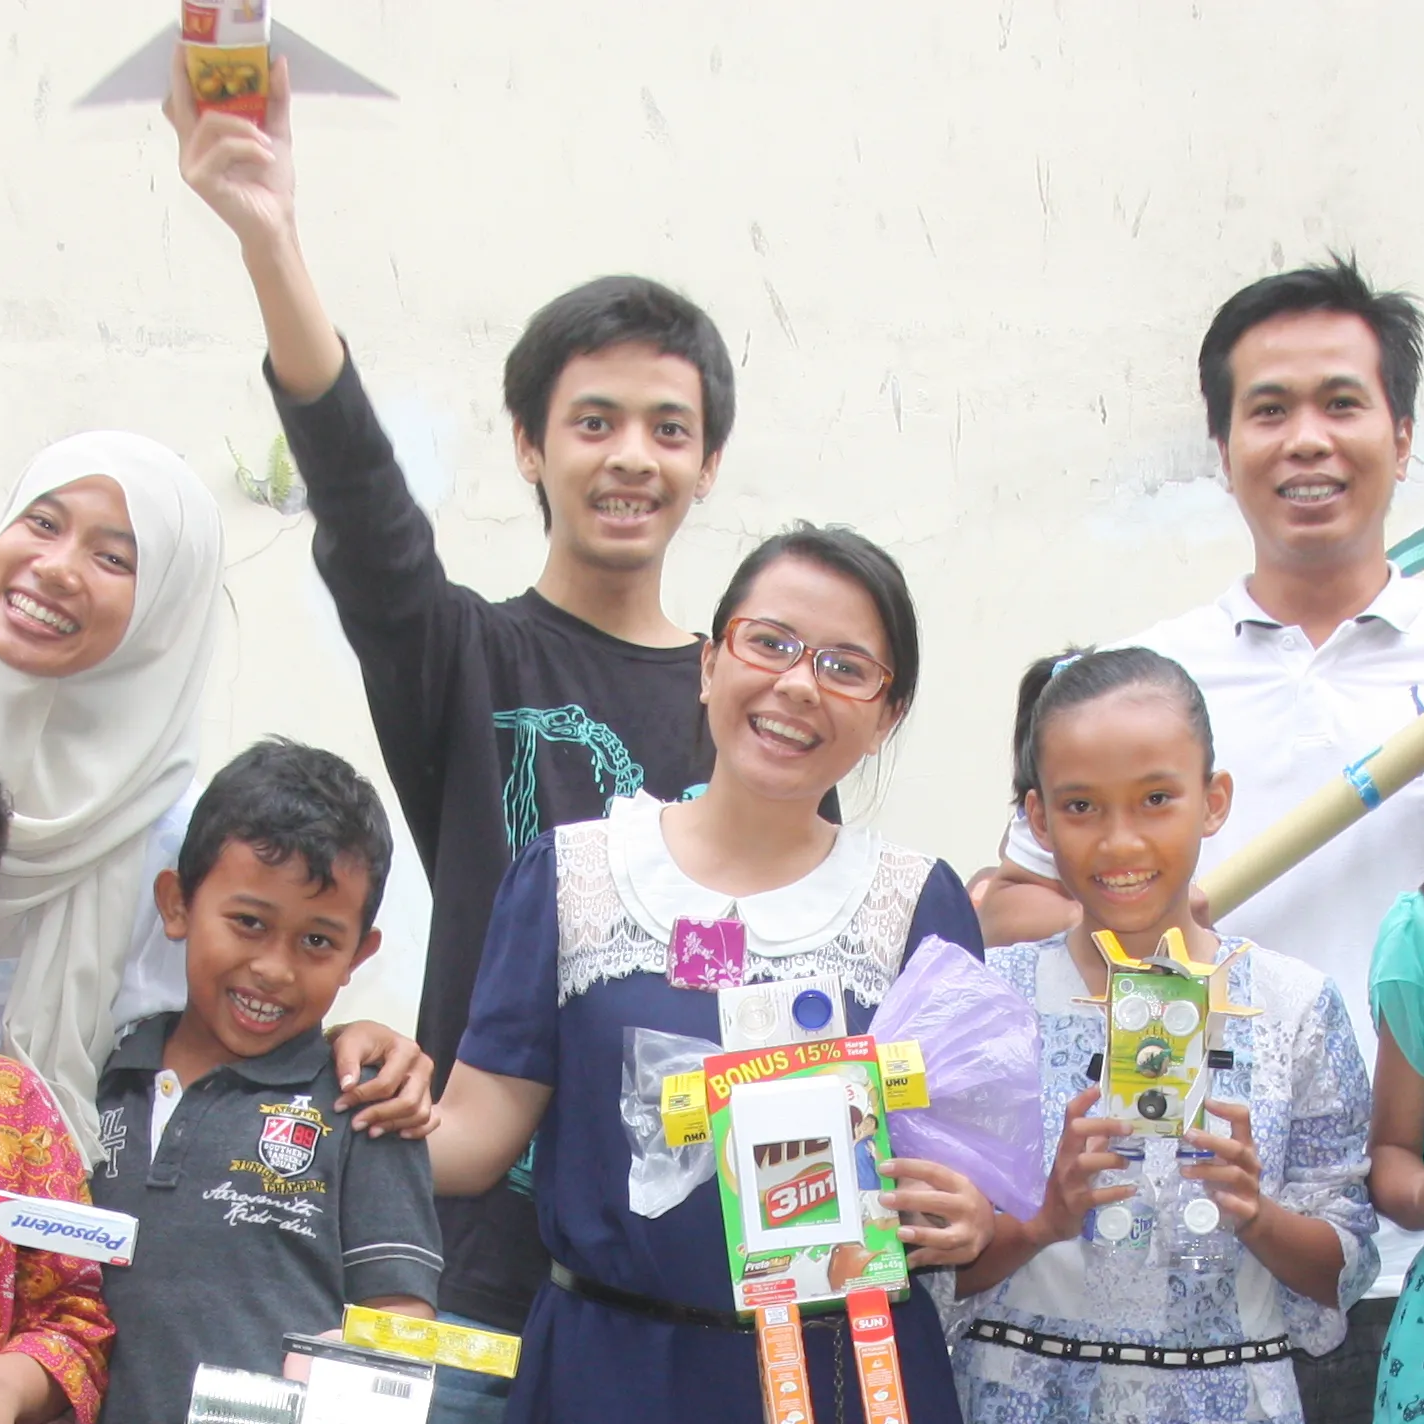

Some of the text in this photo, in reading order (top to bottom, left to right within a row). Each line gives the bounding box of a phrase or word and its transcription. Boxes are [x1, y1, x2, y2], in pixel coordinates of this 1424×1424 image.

[708, 1041, 842, 1100] BONUS 15%
[885, 1078, 908, 1087] UHU
[683, 1132, 707, 1143] UHU
[10, 1214, 128, 1251] Pepsodent
[858, 1317, 883, 1329] SUN
